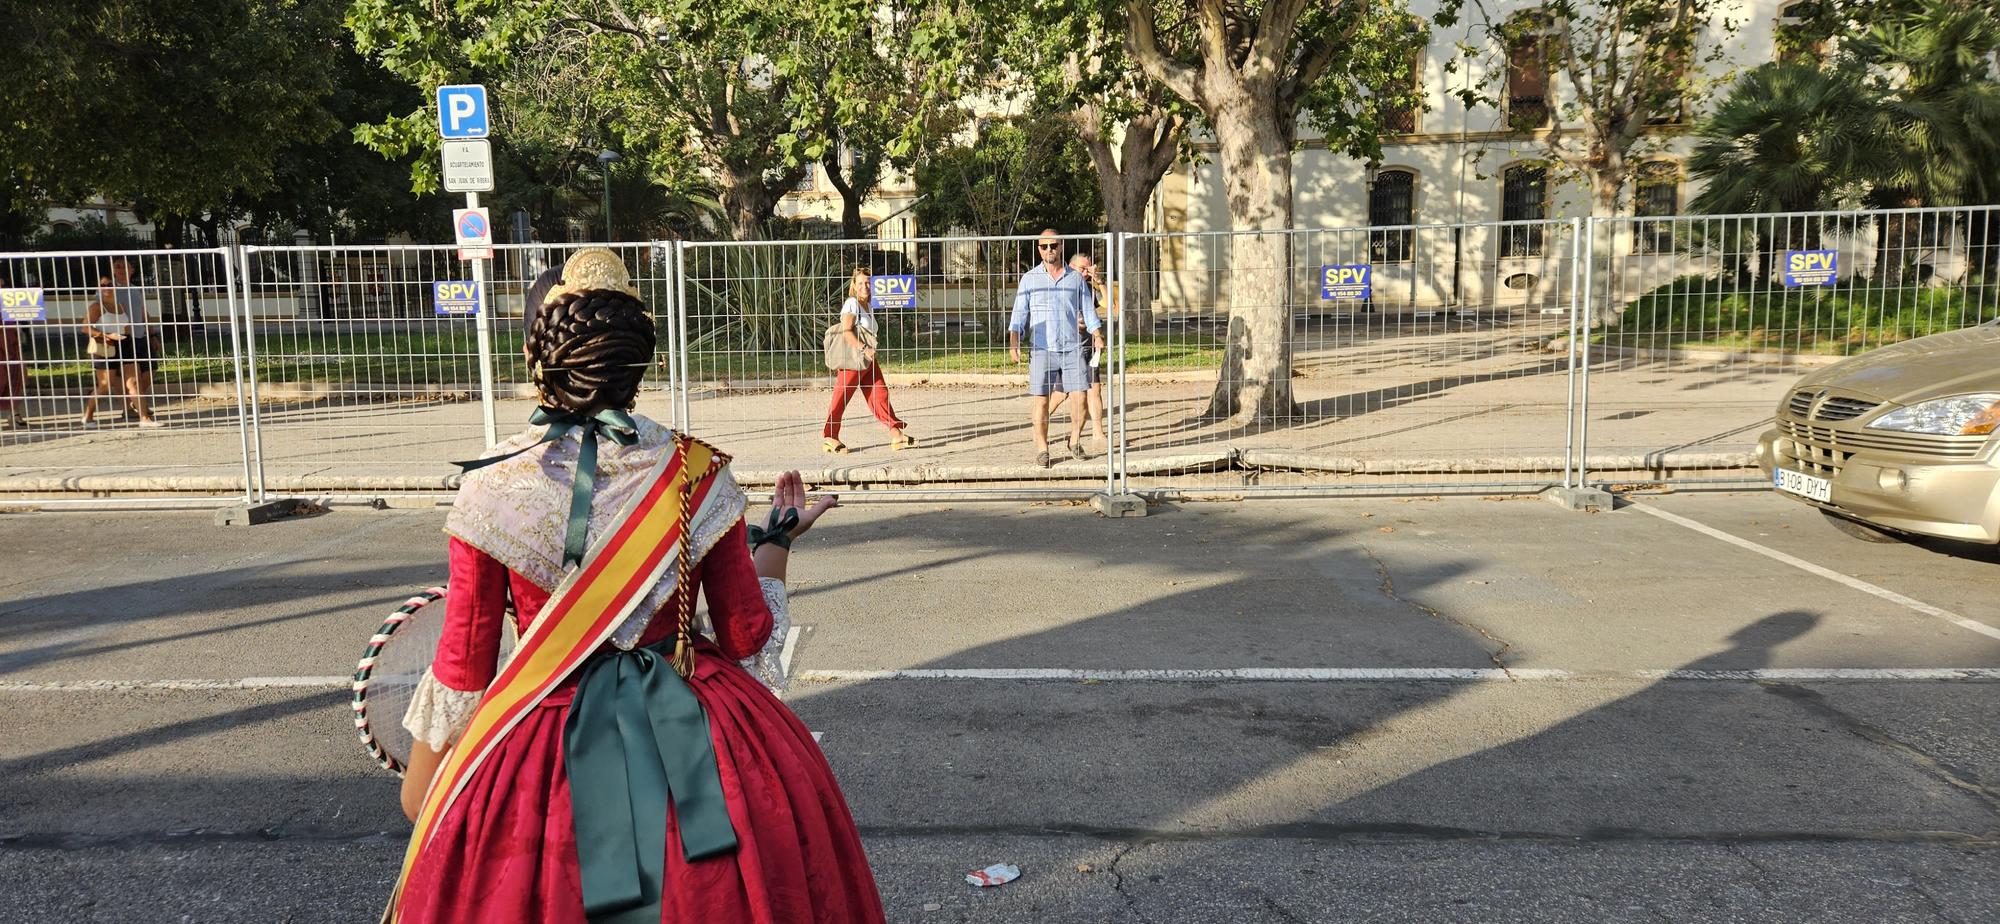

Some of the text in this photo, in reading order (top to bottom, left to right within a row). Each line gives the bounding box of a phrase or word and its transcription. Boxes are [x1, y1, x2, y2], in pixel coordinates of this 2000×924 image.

[448, 94, 475, 130] P
[1790, 252, 1834, 270] SPV
[1326, 267, 1366, 284] SPV
[437, 284, 475, 299] SPV
[874, 278, 911, 295] SPV
[2, 291, 39, 307] SPV
